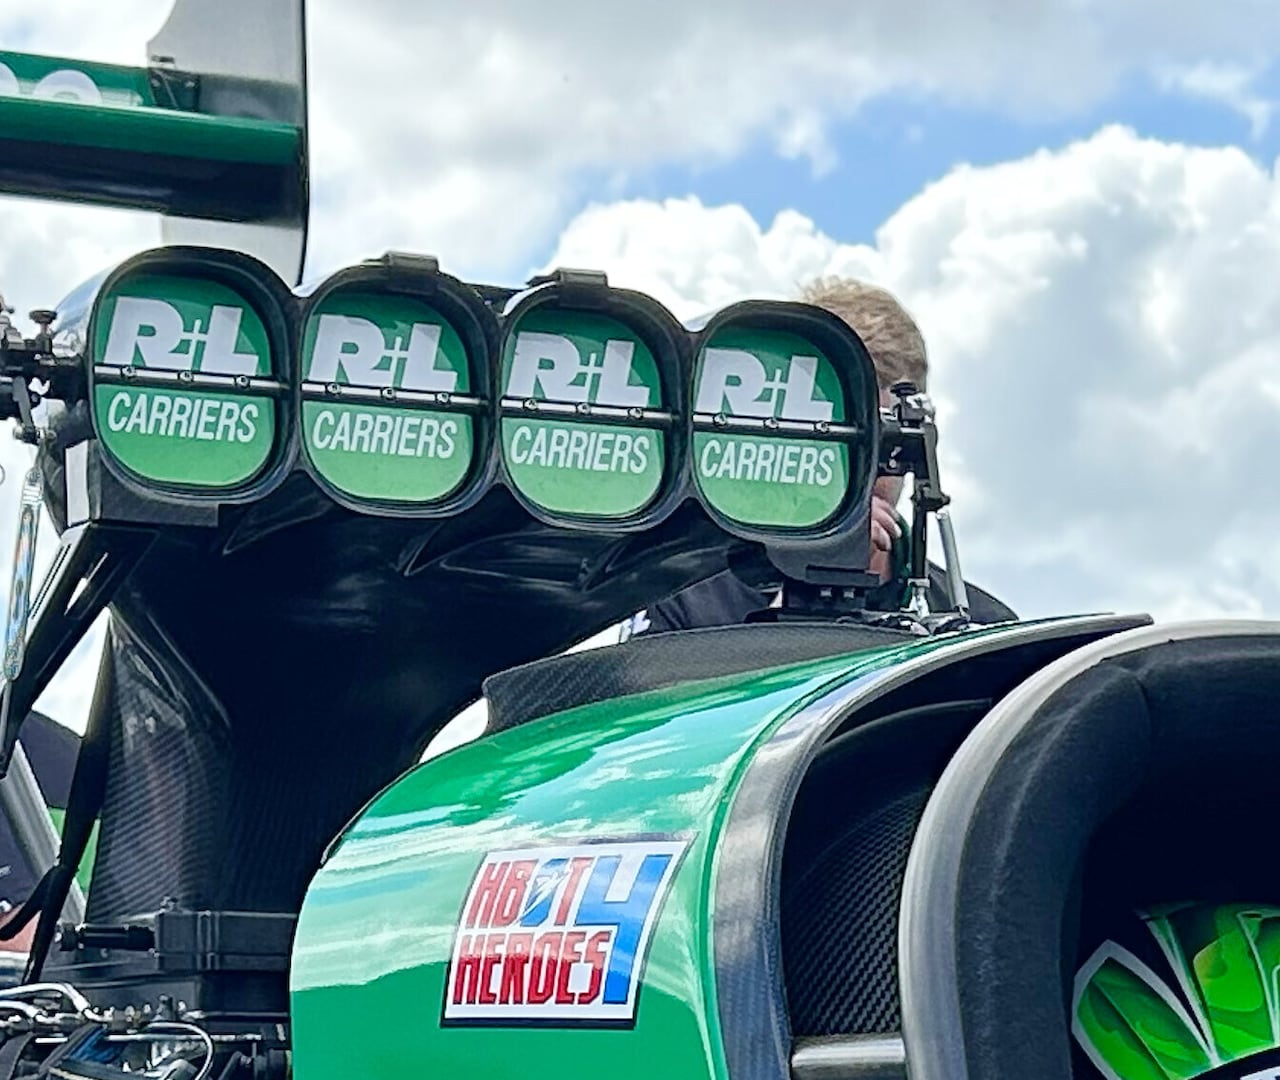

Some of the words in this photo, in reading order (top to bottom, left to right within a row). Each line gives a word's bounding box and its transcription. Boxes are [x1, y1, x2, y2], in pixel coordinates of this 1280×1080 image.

[103, 296, 258, 376] R+L
[308, 314, 458, 393] R+L
[507, 331, 650, 408] R+L
[107, 391, 259, 443] CARRIERS
[695, 348, 834, 422] R+L
[312, 410, 458, 459] CARRIERS
[510, 425, 650, 474] CARRIERS
[700, 439, 836, 486] CARRIERS
[574, 854, 673, 1005] 4
[452, 930, 613, 1005] HEROES
